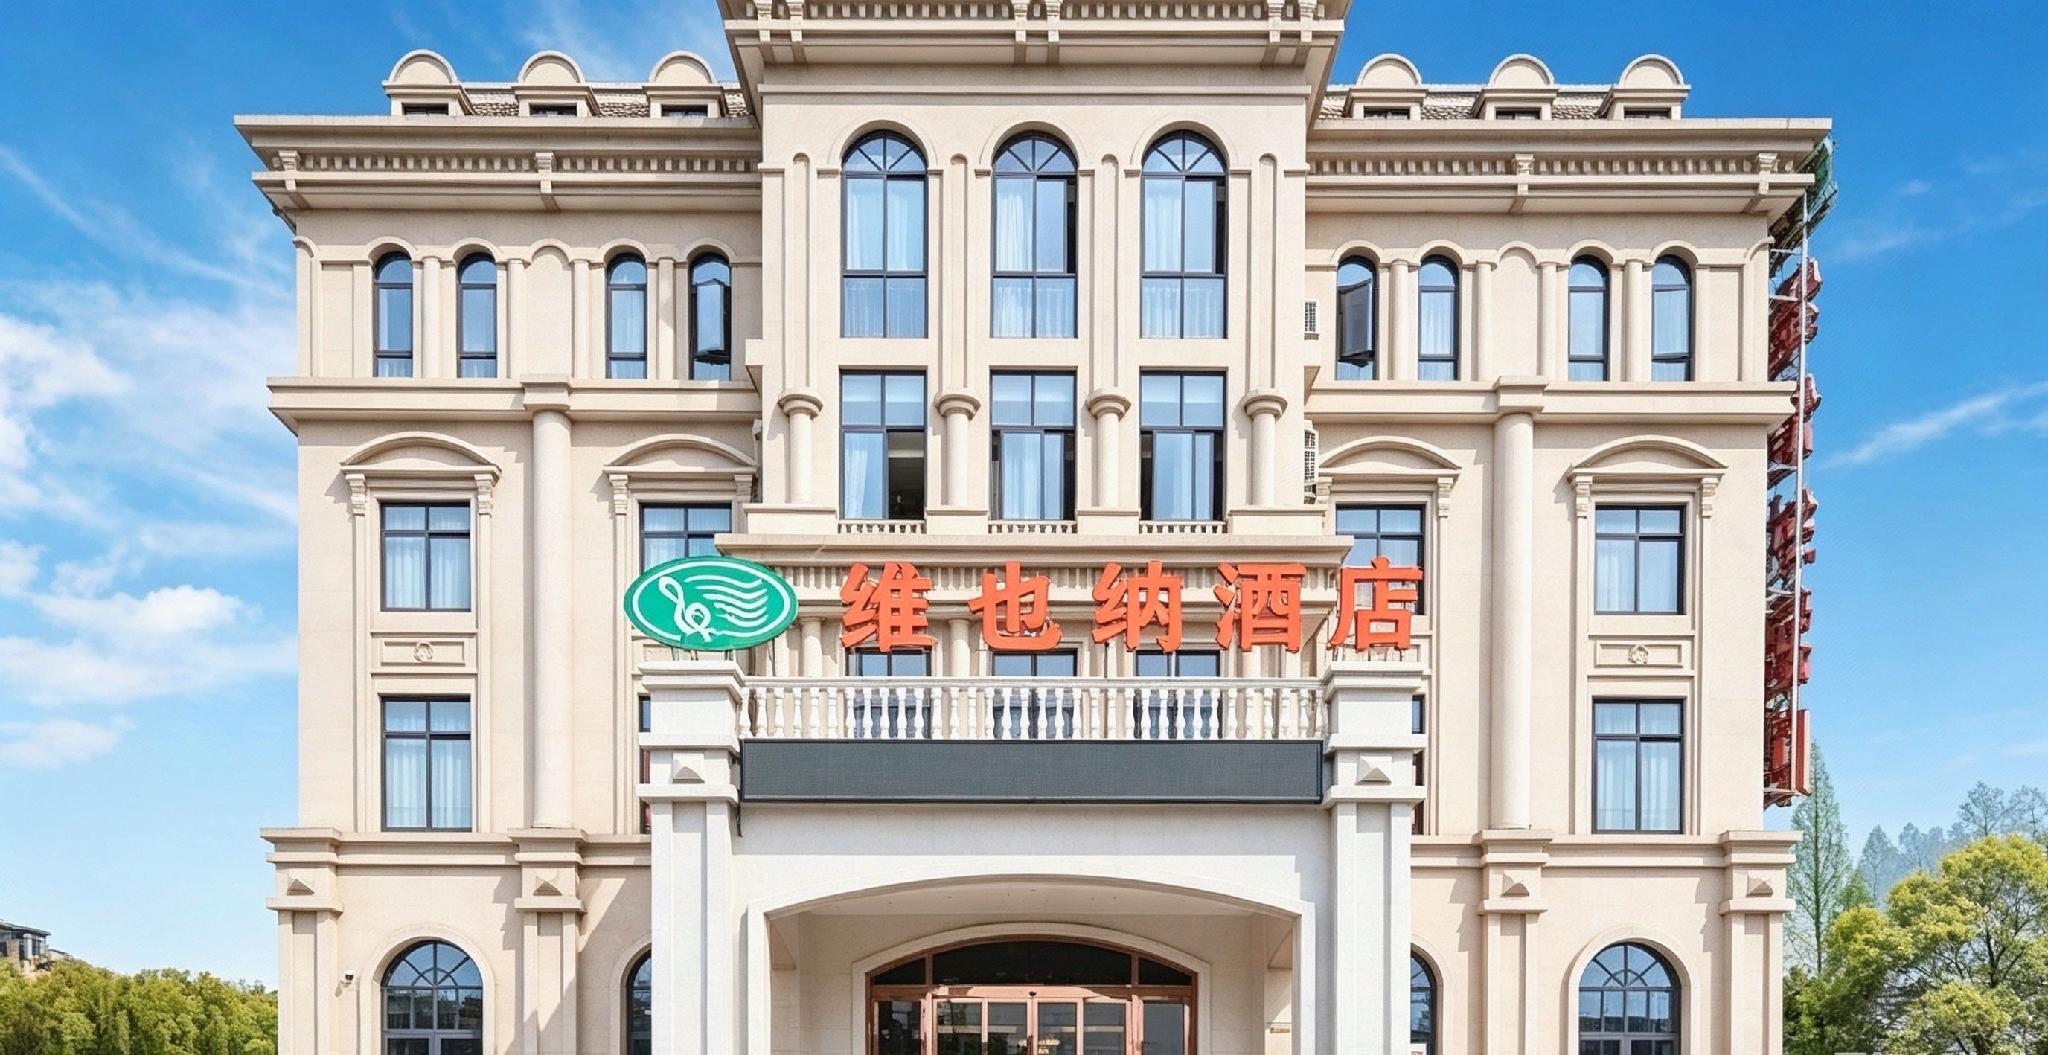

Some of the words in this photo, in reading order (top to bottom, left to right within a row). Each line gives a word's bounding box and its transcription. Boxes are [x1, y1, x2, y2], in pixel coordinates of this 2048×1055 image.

[840, 556, 1423, 653] 维也纳酒店
